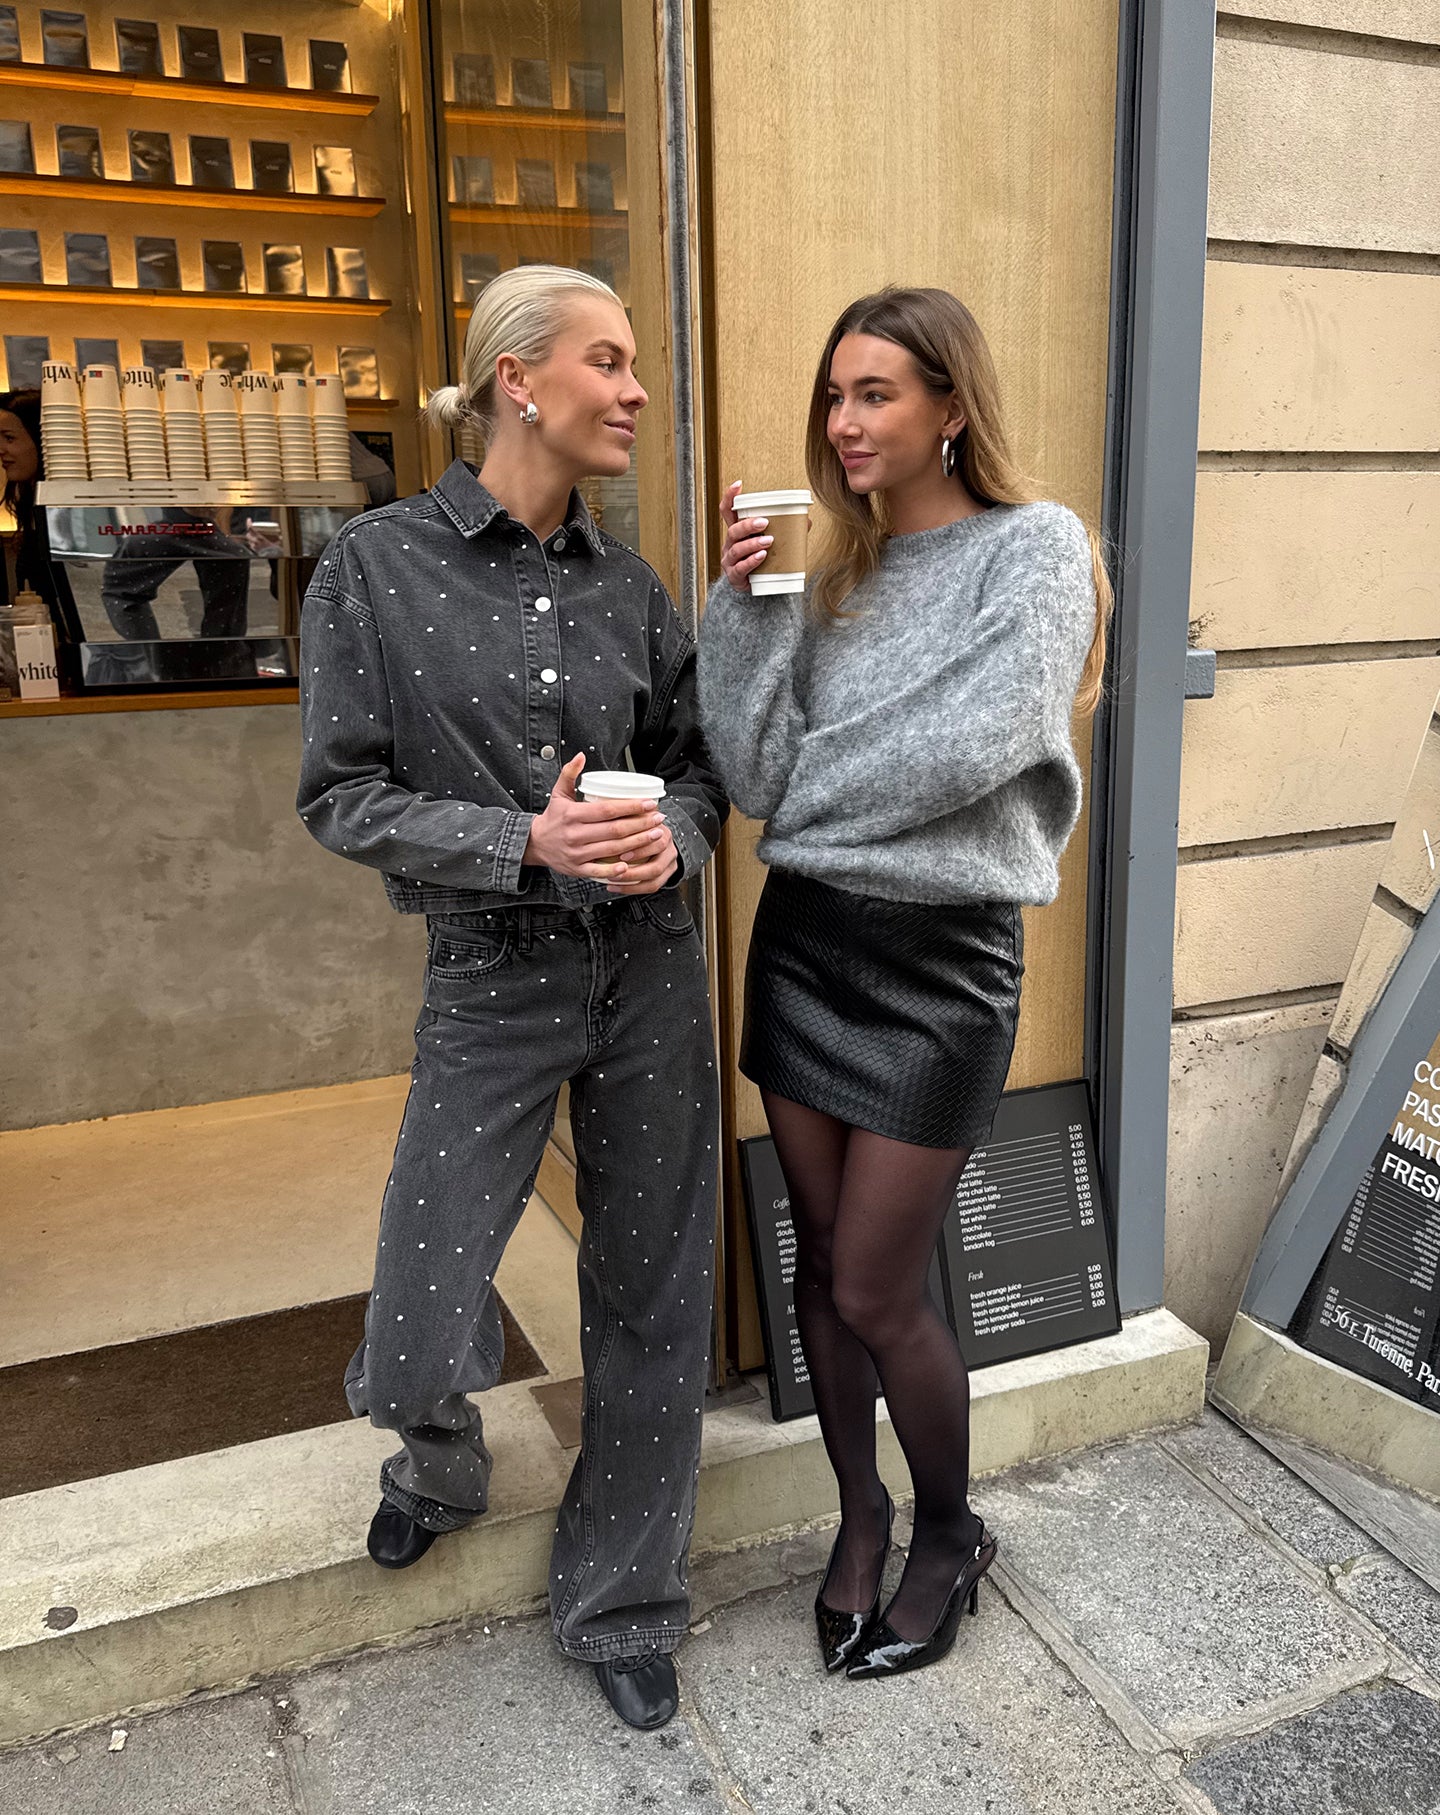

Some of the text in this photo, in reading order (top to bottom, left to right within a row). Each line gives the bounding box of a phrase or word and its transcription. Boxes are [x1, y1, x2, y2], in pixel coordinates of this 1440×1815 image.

[1068, 1124, 1082, 1133] 5.00
[1071, 1141, 1085, 1149] 4.50
[969, 1132, 1083, 1160] ccino 5.00
[1072, 1149, 1086, 1158] 4.00
[1073, 1158, 1087, 1167] 6.00
[956, 1166, 1088, 1199] dirty chai latte 6.50
[957, 1175, 1089, 1207] cinnamon latte 6.00
[1381, 1152, 1440, 1203] FRES
[959, 1183, 1090, 1216] spanish latte 6.00
[960, 1191, 1091, 1225] flat white 5.50
[776, 1228, 795, 1237] doub
[961, 1200, 1093, 1234] mocha 5.50
[962, 1209, 1094, 1243] chocolate 5.50
[779, 1245, 797, 1256] amer
[963, 1217, 1095, 1251] london fog 6.00
[780, 1257, 795, 1265] filtre
[968, 1270, 984, 1282] Fresh
[970, 1264, 1101, 1300] fresh orange juice 5.00
[971, 1272, 1103, 1309] fresh lemon juice 5.00
[972, 1281, 1104, 1318] fresh orange-lemon juice 5.00
[973, 1290, 1105, 1327] fresh lemonade 5.00
[974, 1298, 1106, 1336] fresh ginger soda 5.00
[793, 1355, 806, 1364] dirt
[1330, 1305, 1352, 1329] 56
[1415, 1361, 1440, 1396] Par
